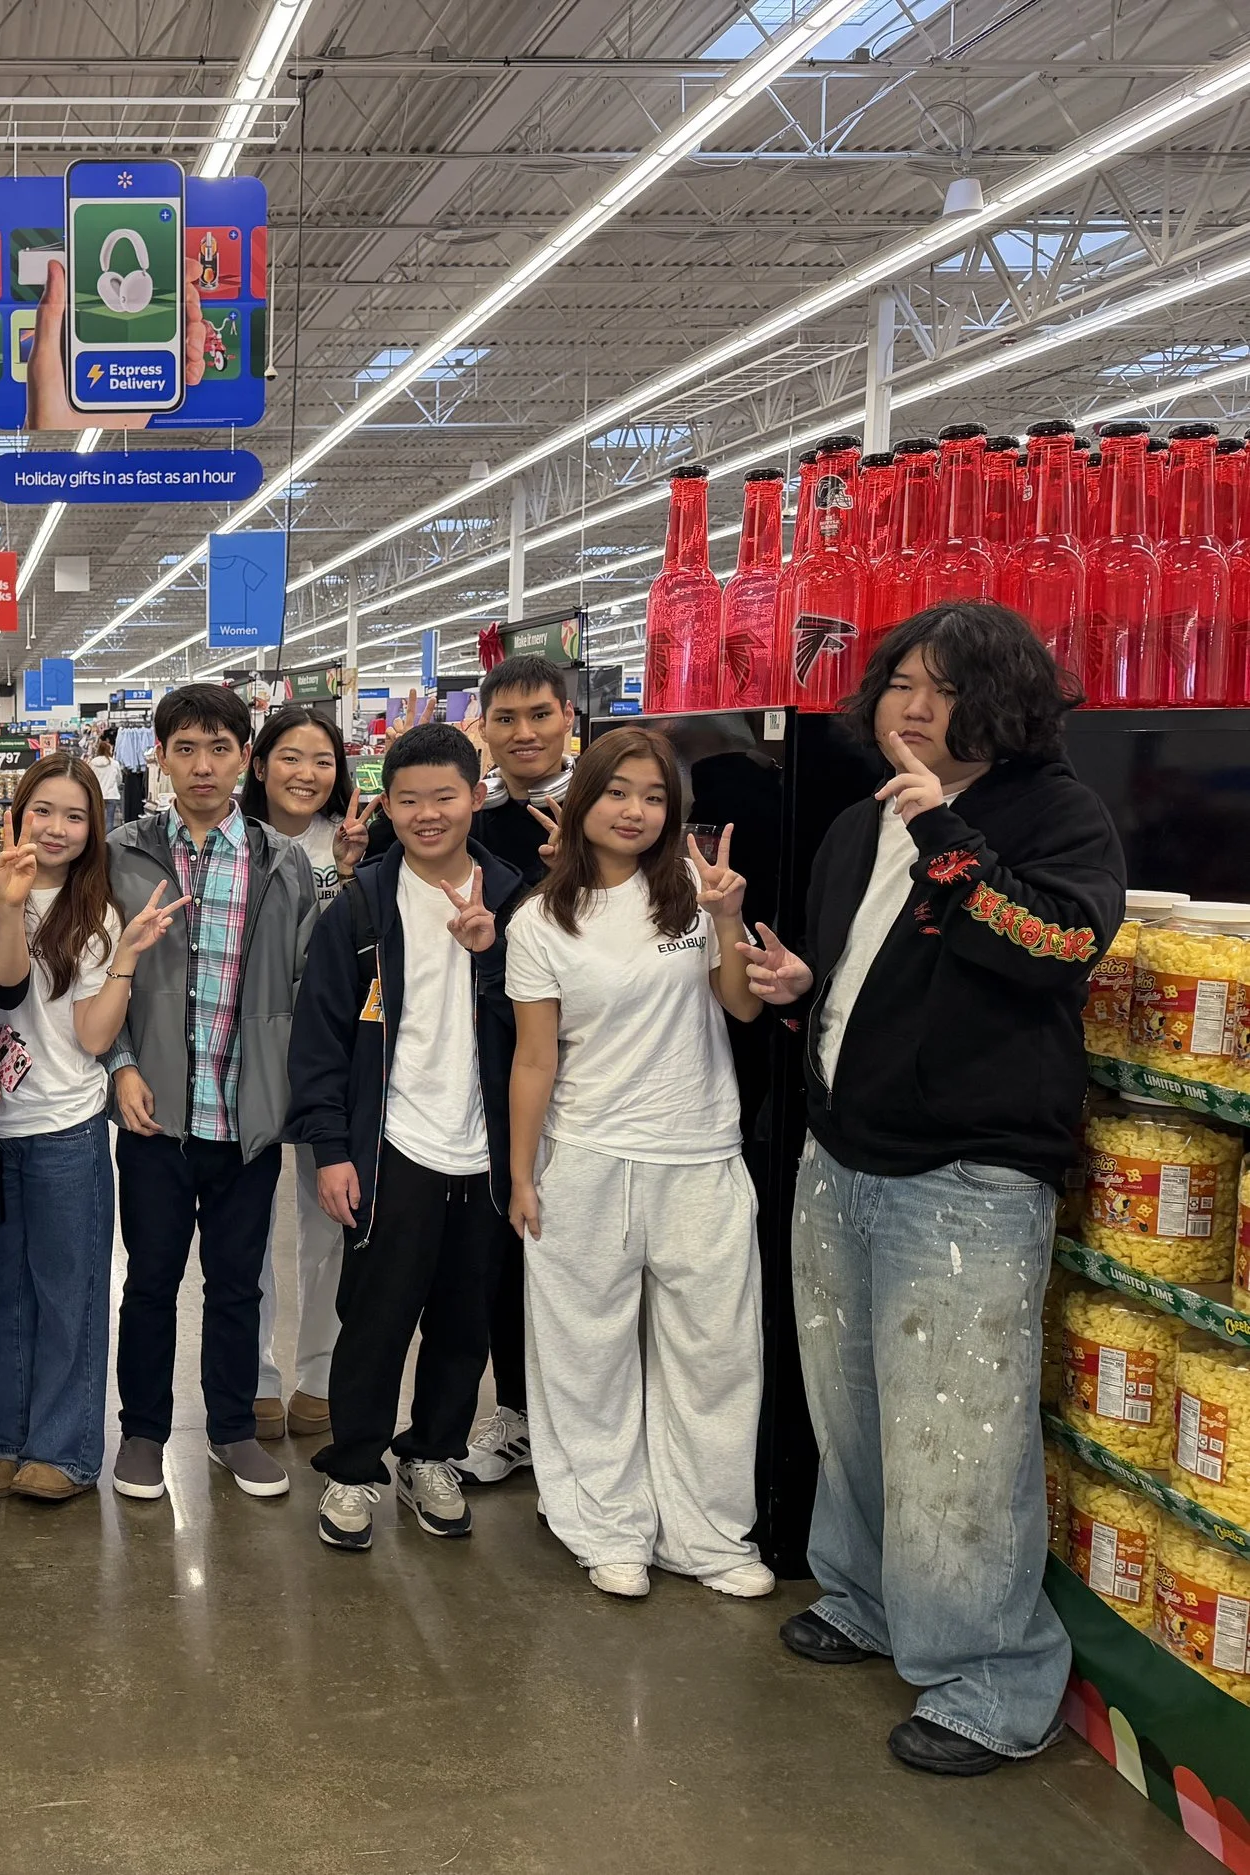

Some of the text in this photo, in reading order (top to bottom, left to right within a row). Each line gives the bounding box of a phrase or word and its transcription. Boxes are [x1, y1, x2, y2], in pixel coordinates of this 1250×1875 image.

[109, 364, 162, 377] Express
[110, 378, 166, 391] Delivery
[15, 469, 236, 488] Holiday gifts in as fast as an hour
[220, 625, 258, 635] Women
[1093, 958, 1128, 976] eetos
[1143, 1074, 1209, 1101] LIMITED TIME
[1091, 1154, 1117, 1173] eetos
[1110, 1267, 1175, 1305] LIMITED TIME
[1101, 1455, 1165, 1501] LIMITED TIME
